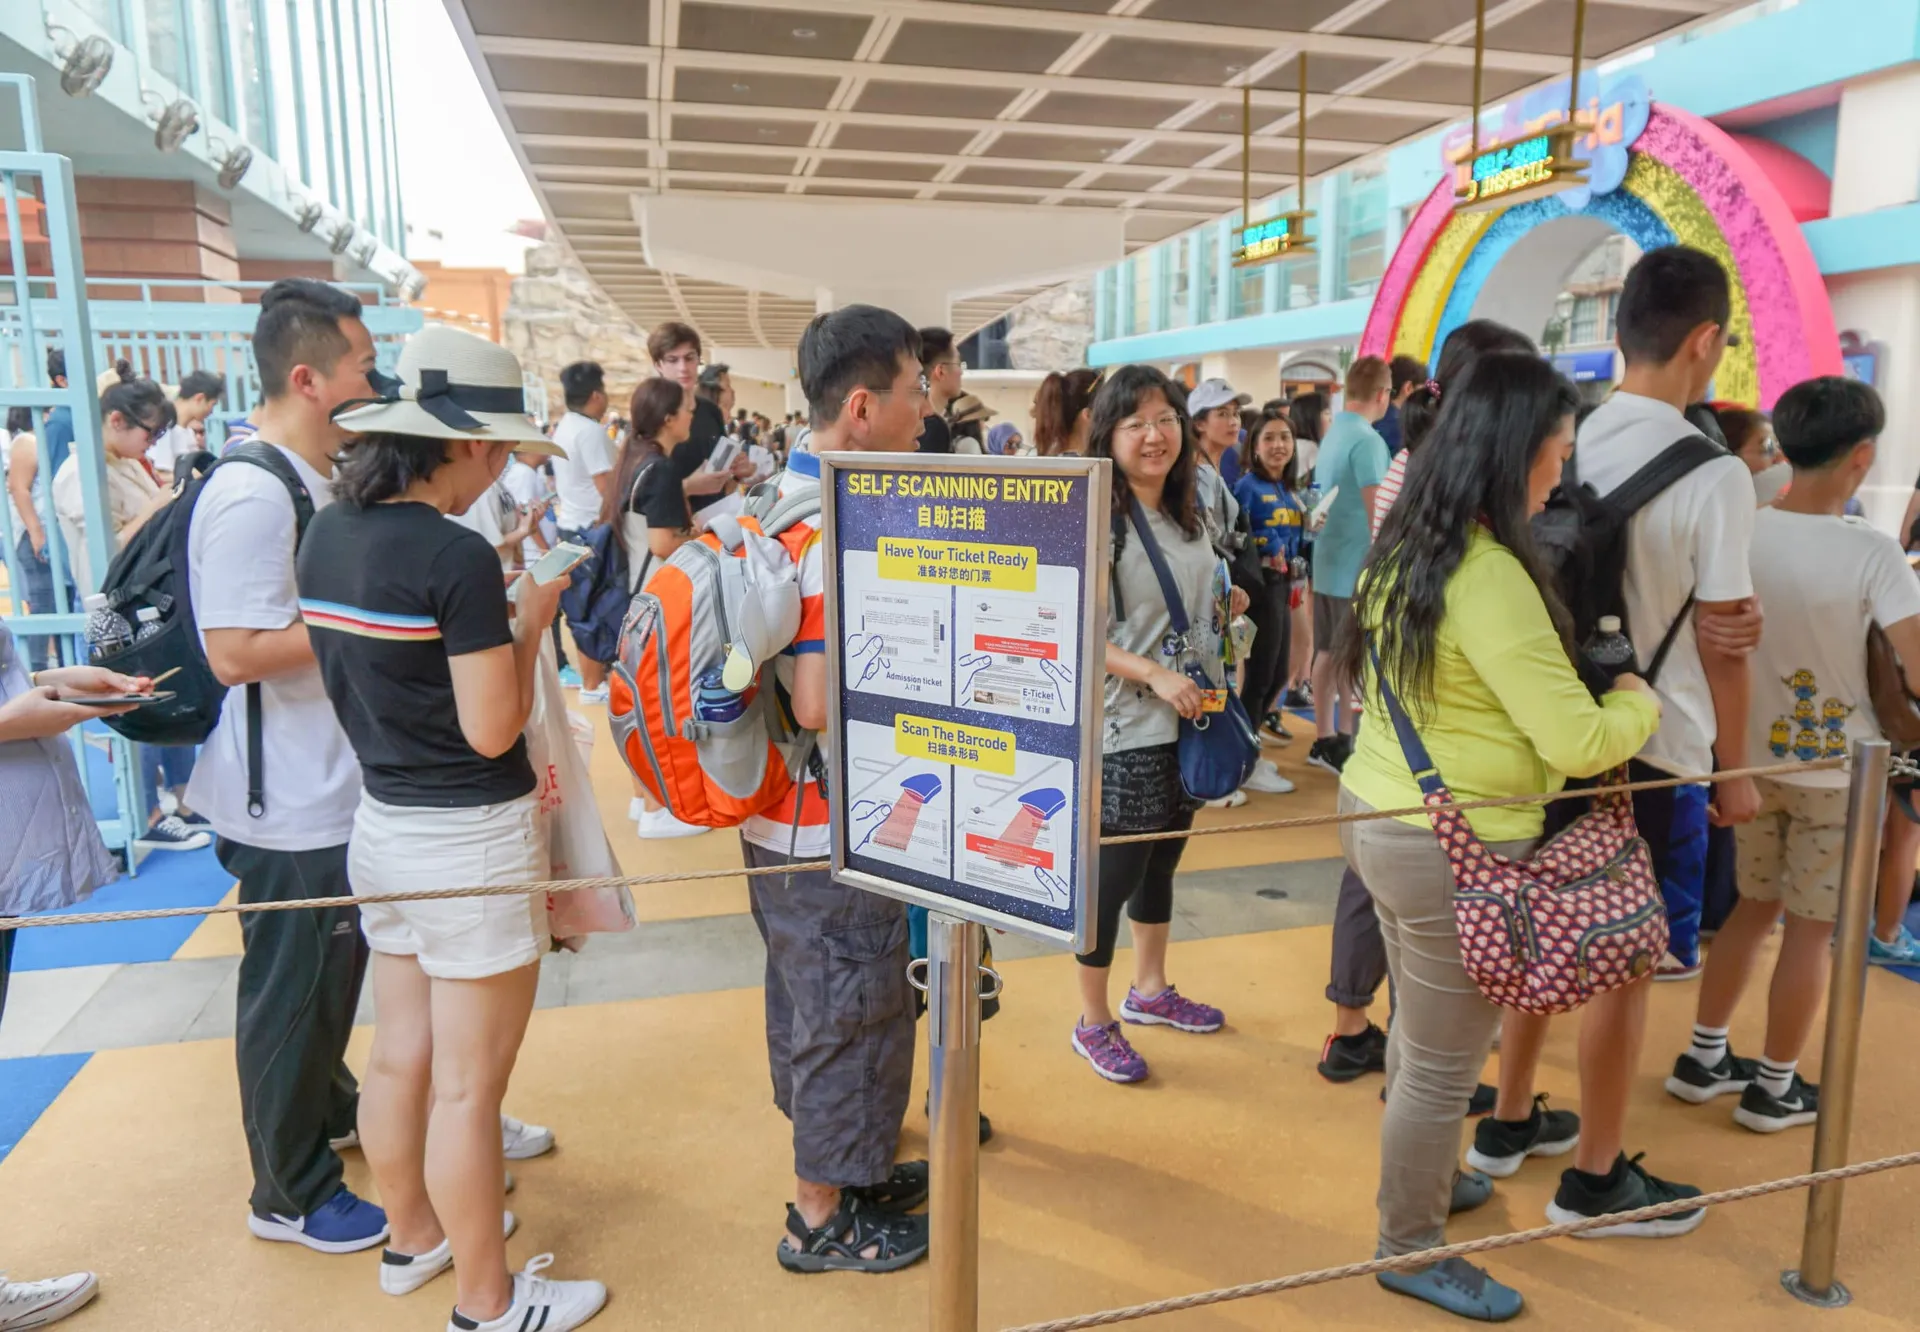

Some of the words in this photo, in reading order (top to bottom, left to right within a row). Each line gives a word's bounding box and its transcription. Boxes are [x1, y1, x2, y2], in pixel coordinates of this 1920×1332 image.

[847, 473, 893, 496] SELF
[896, 475, 998, 501] SCANNING
[1002, 478, 1073, 504] ENTRY
[917, 504, 986, 531] 自助扫描
[885, 543, 914, 558] Have
[917, 545, 944, 560] Your
[947, 548, 985, 564] Ticket
[988, 551, 1029, 570] Ready
[917, 564, 992, 583] 准备好您的门票
[886, 671, 922, 684] Admission
[922, 678, 943, 687] ticket
[1022, 687, 1054, 700] E-Ticket
[902, 720, 930, 737] Scan
[932, 725, 955, 741] The
[957, 729, 1008, 752] Barcode
[928, 741, 979, 762] 扫描条形码
